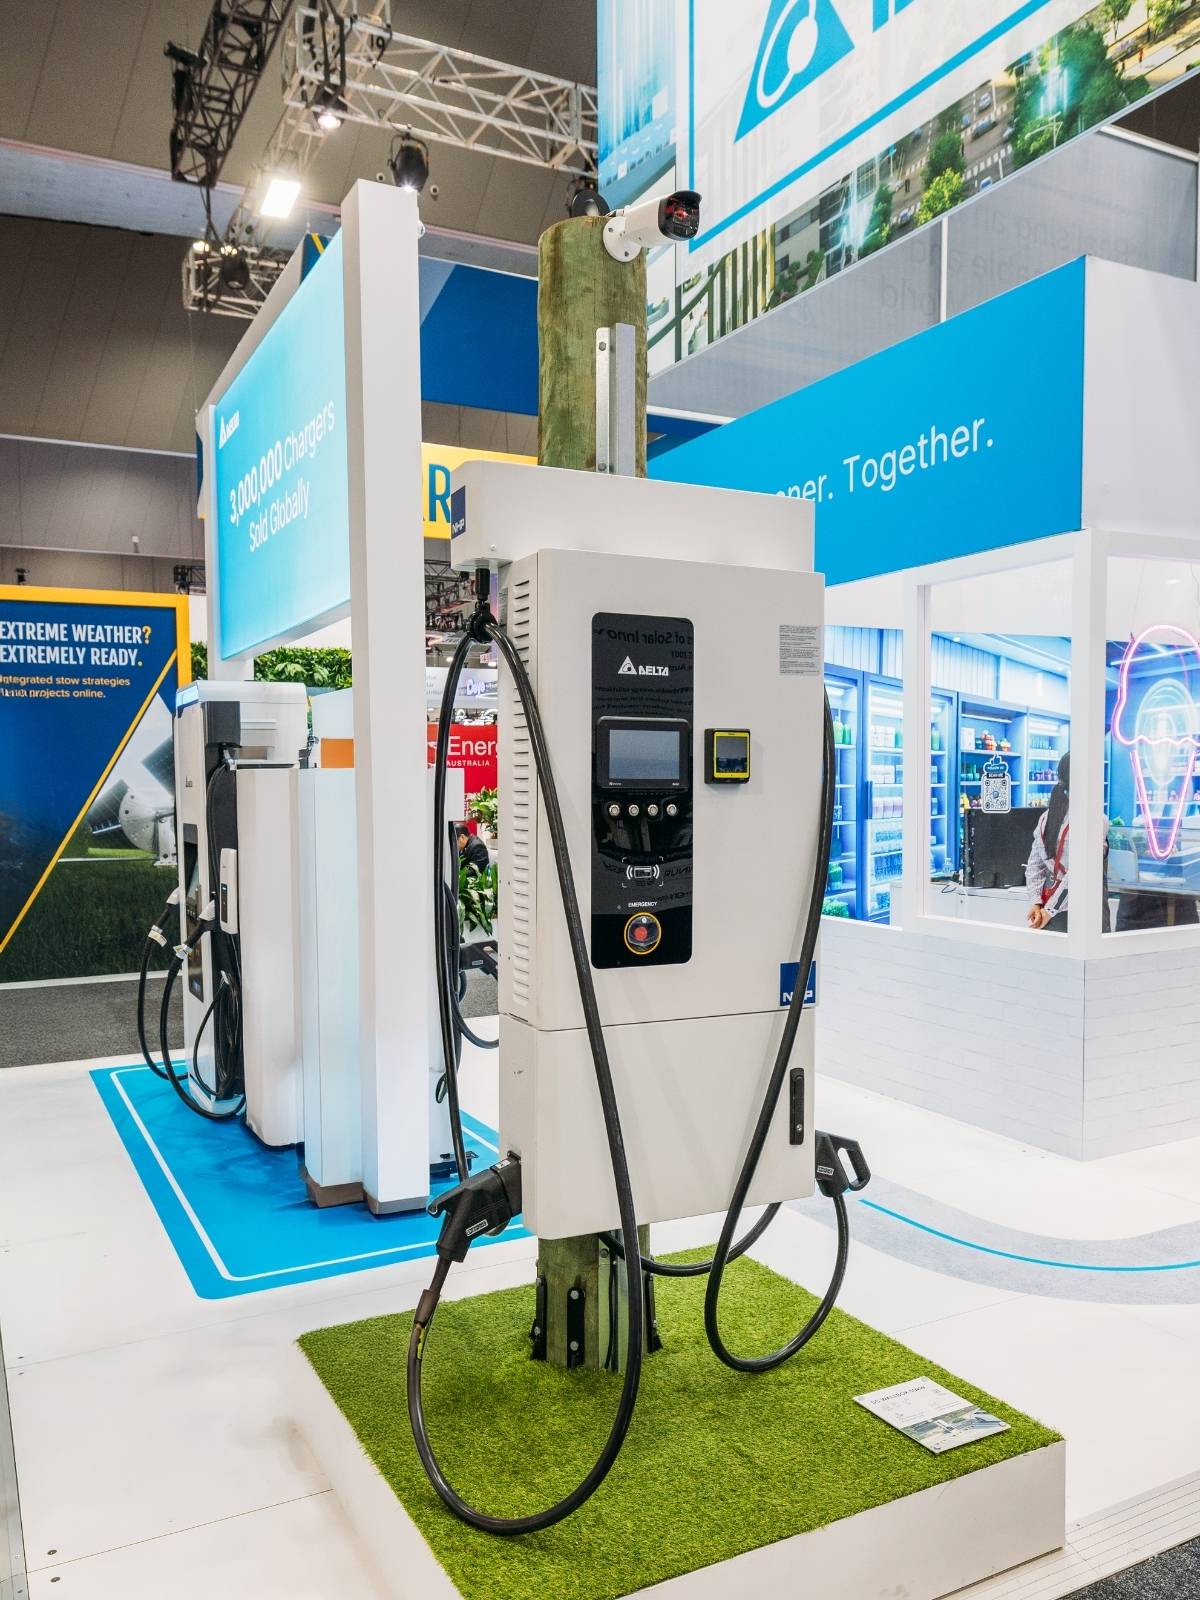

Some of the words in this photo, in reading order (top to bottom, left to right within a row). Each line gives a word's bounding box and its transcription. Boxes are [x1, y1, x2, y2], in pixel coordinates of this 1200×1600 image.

[230, 440, 282, 527] 3,000,000
[284, 400, 335, 471] Chargers
[843, 417, 994, 492] Together.
[249, 509, 268, 552] Sold
[269, 477, 310, 534] Globally
[0, 621, 69, 642] EXTREME
[71, 624, 152, 645] WEATHER?
[0, 645, 86, 665] EXTREMELY
[90, 648, 143, 667] READY.
[638, 665, 669, 676] DELTA
[55, 676, 80, 686] stow
[82, 677, 131, 688] strategies
[72, 690, 106, 699] online.
[448, 735, 498, 759] Ener
[446, 759, 490, 767] AUSTRALIA
[782, 989, 813, 1003] NP
